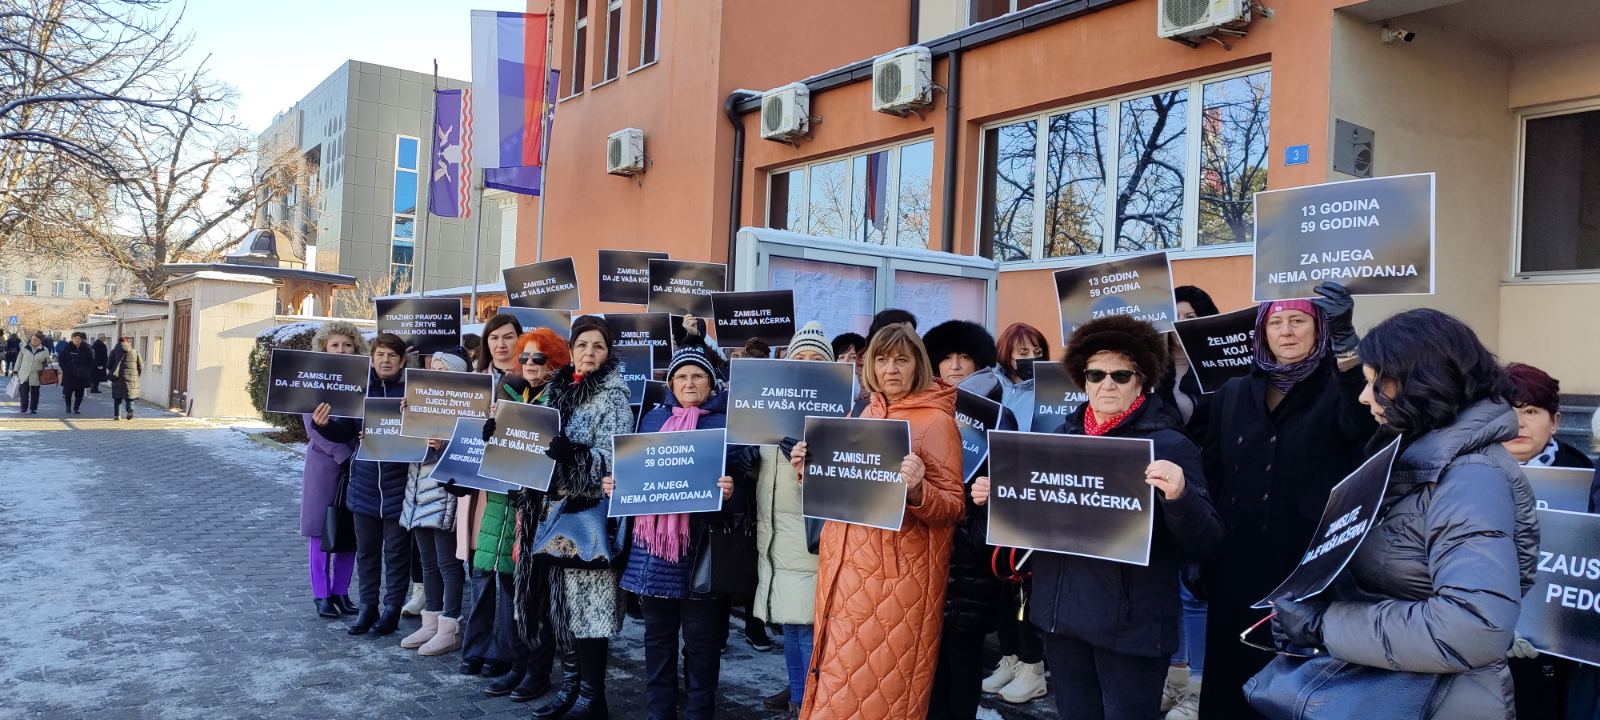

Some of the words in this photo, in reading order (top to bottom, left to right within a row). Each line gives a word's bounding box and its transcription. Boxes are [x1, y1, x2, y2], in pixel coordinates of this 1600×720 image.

[1293, 149, 1299, 160] 3
[1301, 205, 1316, 216] 13
[1320, 198, 1380, 214] GODINA
[1300, 221, 1316, 233] 59
[1320, 215, 1380, 231] GODINA
[1300, 254, 1318, 265] ZA
[1322, 249, 1374, 263] NJEGA
[617, 268, 649, 276] ZAMISLITE
[1088, 278, 1099, 286] 13
[1101, 270, 1140, 283] GODINA
[1269, 270, 1307, 284] NEMA
[1311, 264, 1418, 280] OPRAVDANJA
[523, 278, 556, 289] ZAMISLITE
[620, 275, 637, 283] VAŠA
[670, 278, 704, 287] ZAMISLITE
[528, 288, 546, 296] VAŠA
[674, 286, 691, 294] VAŠA
[1090, 289, 1100, 298] 59
[1102, 282, 1141, 295] GODINA
[734, 309, 772, 317] ZAMISLITE
[1092, 310, 1105, 319] ZA
[1107, 305, 1140, 316] NJEGA
[738, 318, 758, 326] VAŠA
[760, 316, 791, 325] KĆERKA
[1208, 333, 1246, 346] ŽELIMO
[1223, 345, 1248, 355] KOJI
[1202, 360, 1217, 368] NA
[297, 372, 343, 381] ZAMISLITE
[275, 379, 288, 387] DA
[302, 381, 325, 390] VAŠA
[326, 383, 362, 392] KĆERKA
[415, 387, 445, 396] TRAŽIMO
[446, 390, 473, 399] PRAVDU
[474, 392, 484, 400] ZA
[760, 387, 818, 398] ZAMISLITE
[425, 398, 448, 406] DJECU
[449, 399, 471, 408] ŽRTVE
[735, 400, 750, 409] DA
[752, 400, 764, 409] JE
[767, 399, 796, 410] VAŠA
[798, 401, 844, 413] KĆERKA
[410, 406, 456, 415] SEKSUALNOG
[457, 410, 486, 418] NASILJA
[1039, 405, 1053, 414] DA
[1054, 405, 1067, 415] JE
[383, 427, 399, 435] VAŠA
[972, 420, 984, 431] ZA
[505, 428, 540, 441] ZAMISLITE
[489, 437, 498, 445] DA
[499, 438, 508, 448] JE
[508, 440, 524, 451] VAŠA
[645, 447, 656, 455] 13
[658, 445, 695, 455] GODINA
[644, 458, 655, 467] 59
[657, 456, 695, 467] GODINA
[833, 451, 881, 466] ZAMISLITE
[810, 465, 823, 475] DA
[825, 466, 836, 477] JE
[838, 466, 862, 479] VAŠA
[864, 468, 902, 483] KĆERKA
[1030, 471, 1104, 489] ZAMISLITE
[643, 482, 656, 491] ZA
[657, 480, 689, 490] NJEGA
[620, 494, 647, 504] NEMA
[649, 490, 713, 502] OPRAVDANJA
[997, 486, 1017, 498] DA
[1020, 488, 1036, 500] JE
[1040, 489, 1078, 504] VAŠA
[1080, 492, 1142, 511] KĆERKA
[1325, 505, 1362, 538] ZAMISLITE
[1302, 549, 1314, 565] DA
[1311, 544, 1322, 560] JE
[1319, 534, 1340, 555] VAŠA
[1337, 518, 1368, 545] KĆERKA
